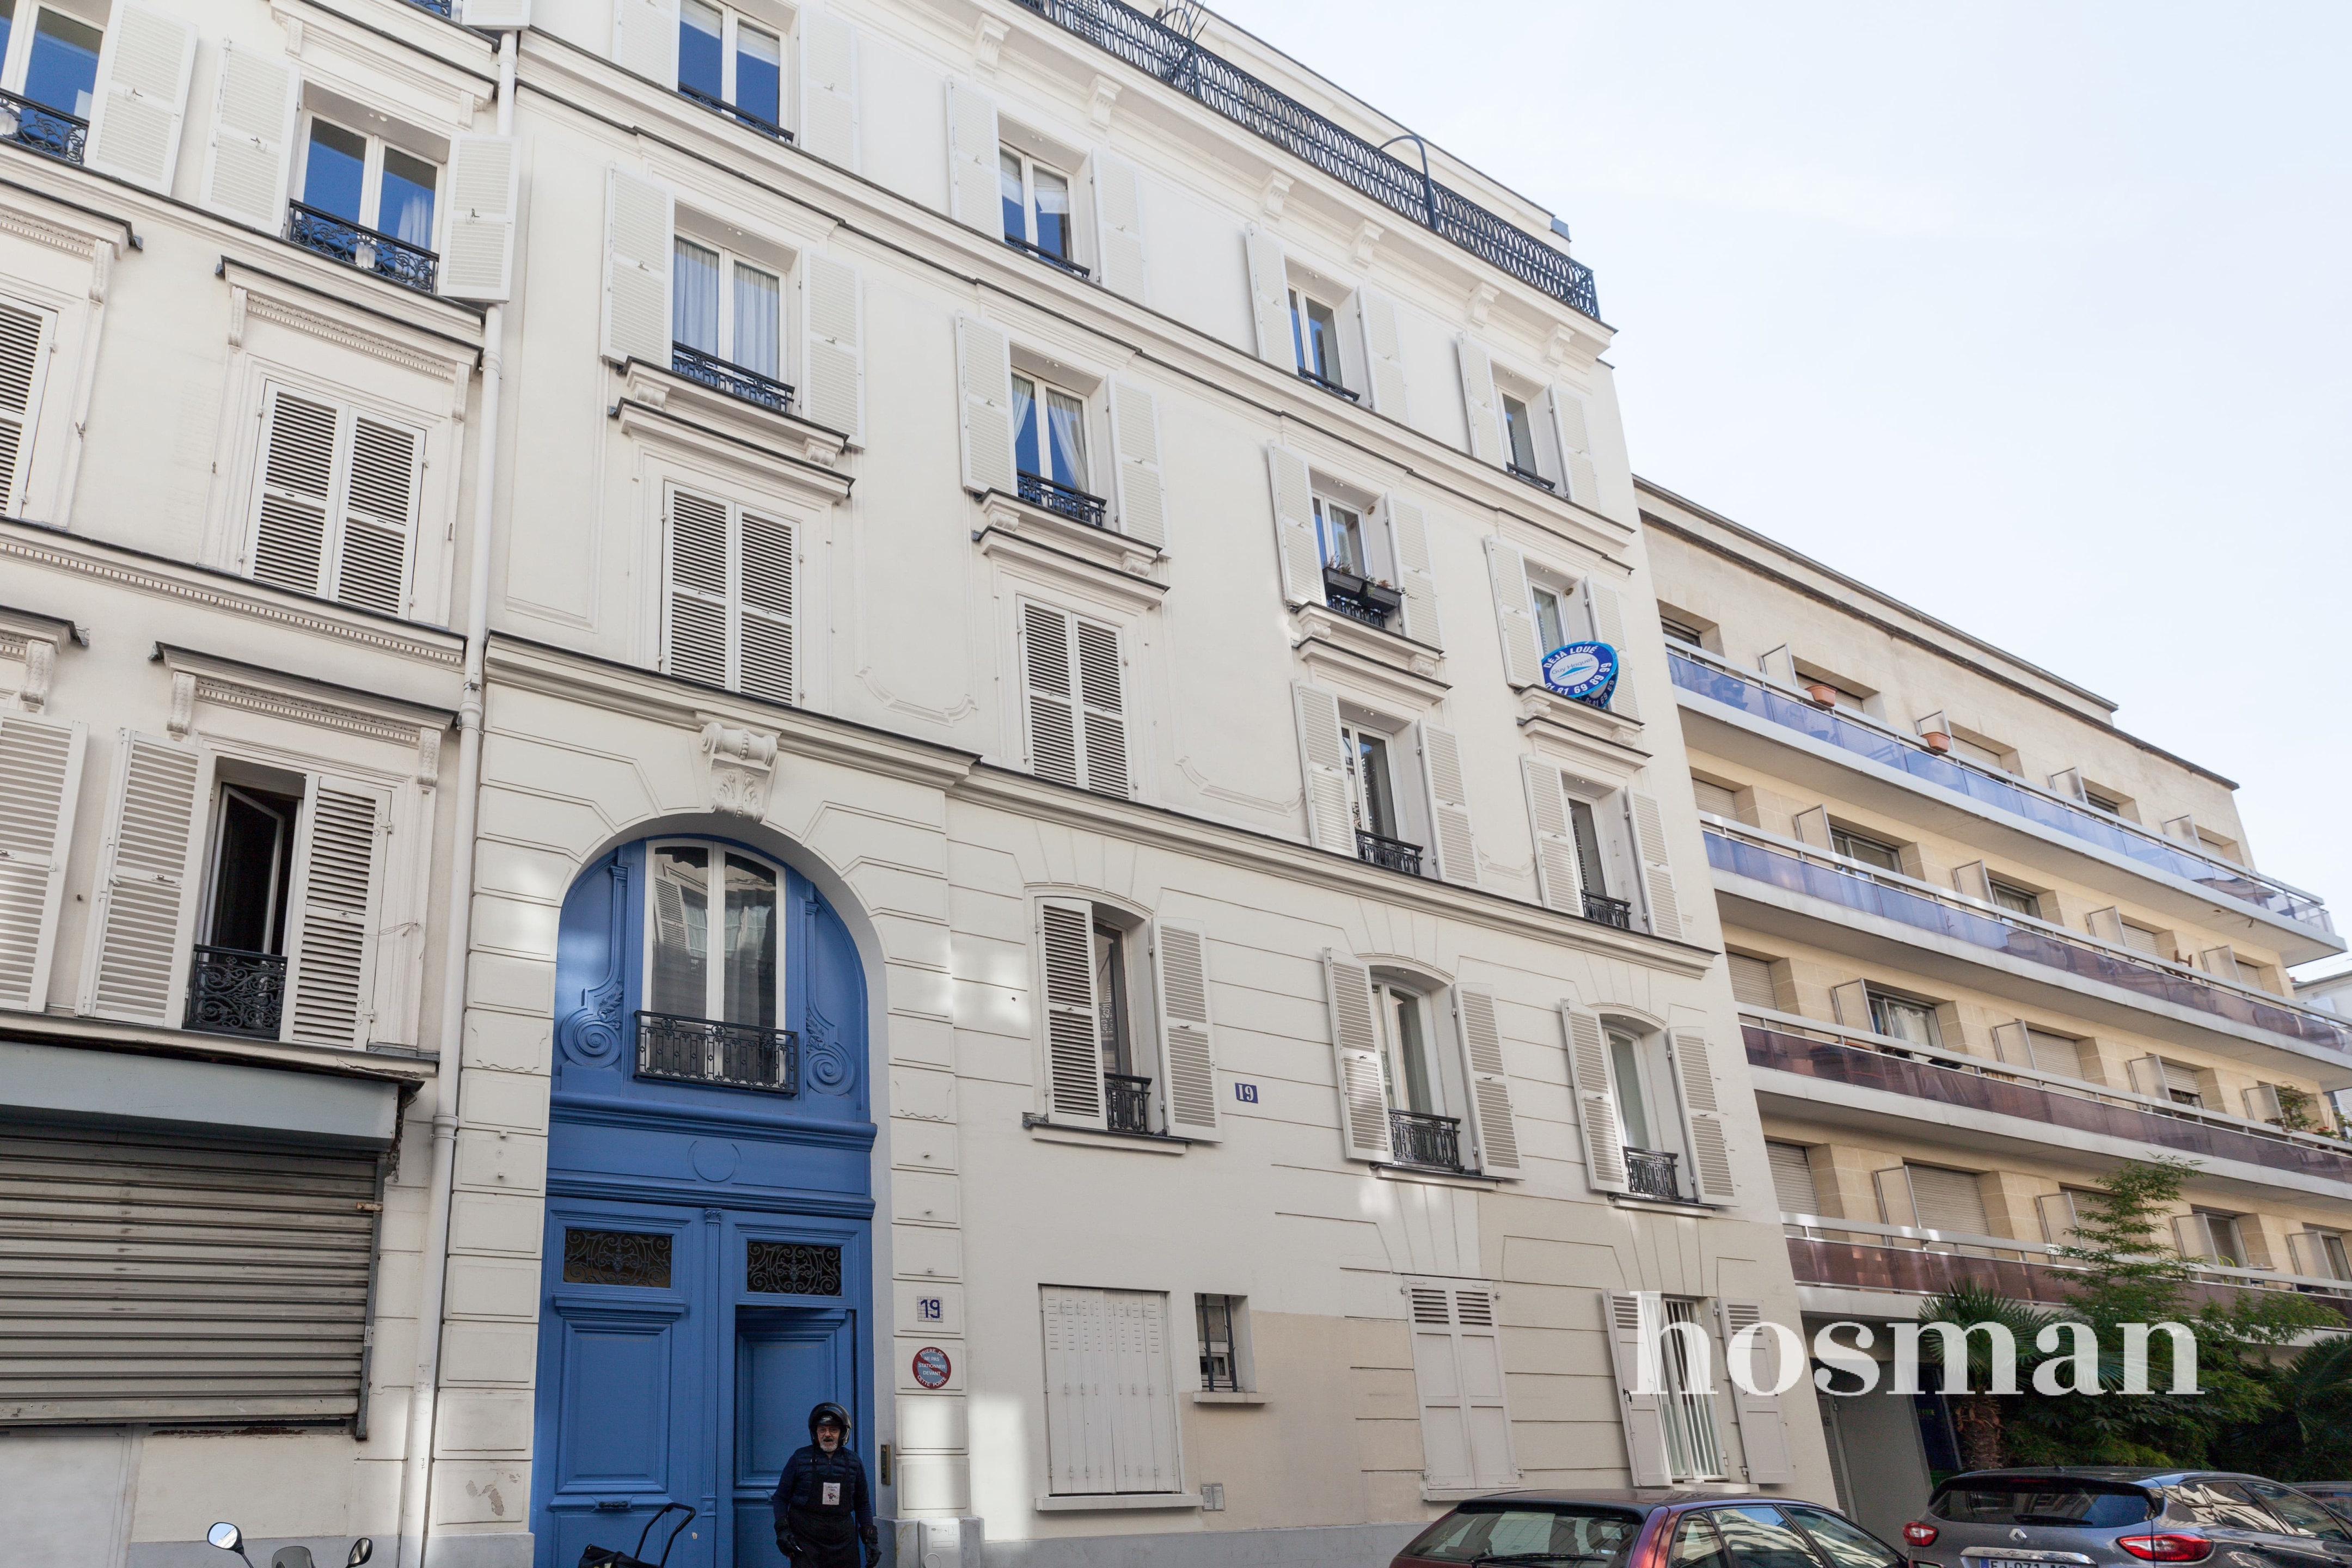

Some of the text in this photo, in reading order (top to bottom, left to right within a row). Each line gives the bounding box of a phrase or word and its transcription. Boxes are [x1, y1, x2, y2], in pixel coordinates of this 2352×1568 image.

[1543, 646, 1598, 668] DÉJÀ LOUÉ
[1574, 684, 1588, 694] 69
[1590, 675, 1604, 685] 89
[1599, 663, 1612, 672] 99
[1238, 1084, 1254, 1101] 19
[921, 1299, 940, 1319] 19
[917, 1375, 947, 1387] CETTE PORTE
